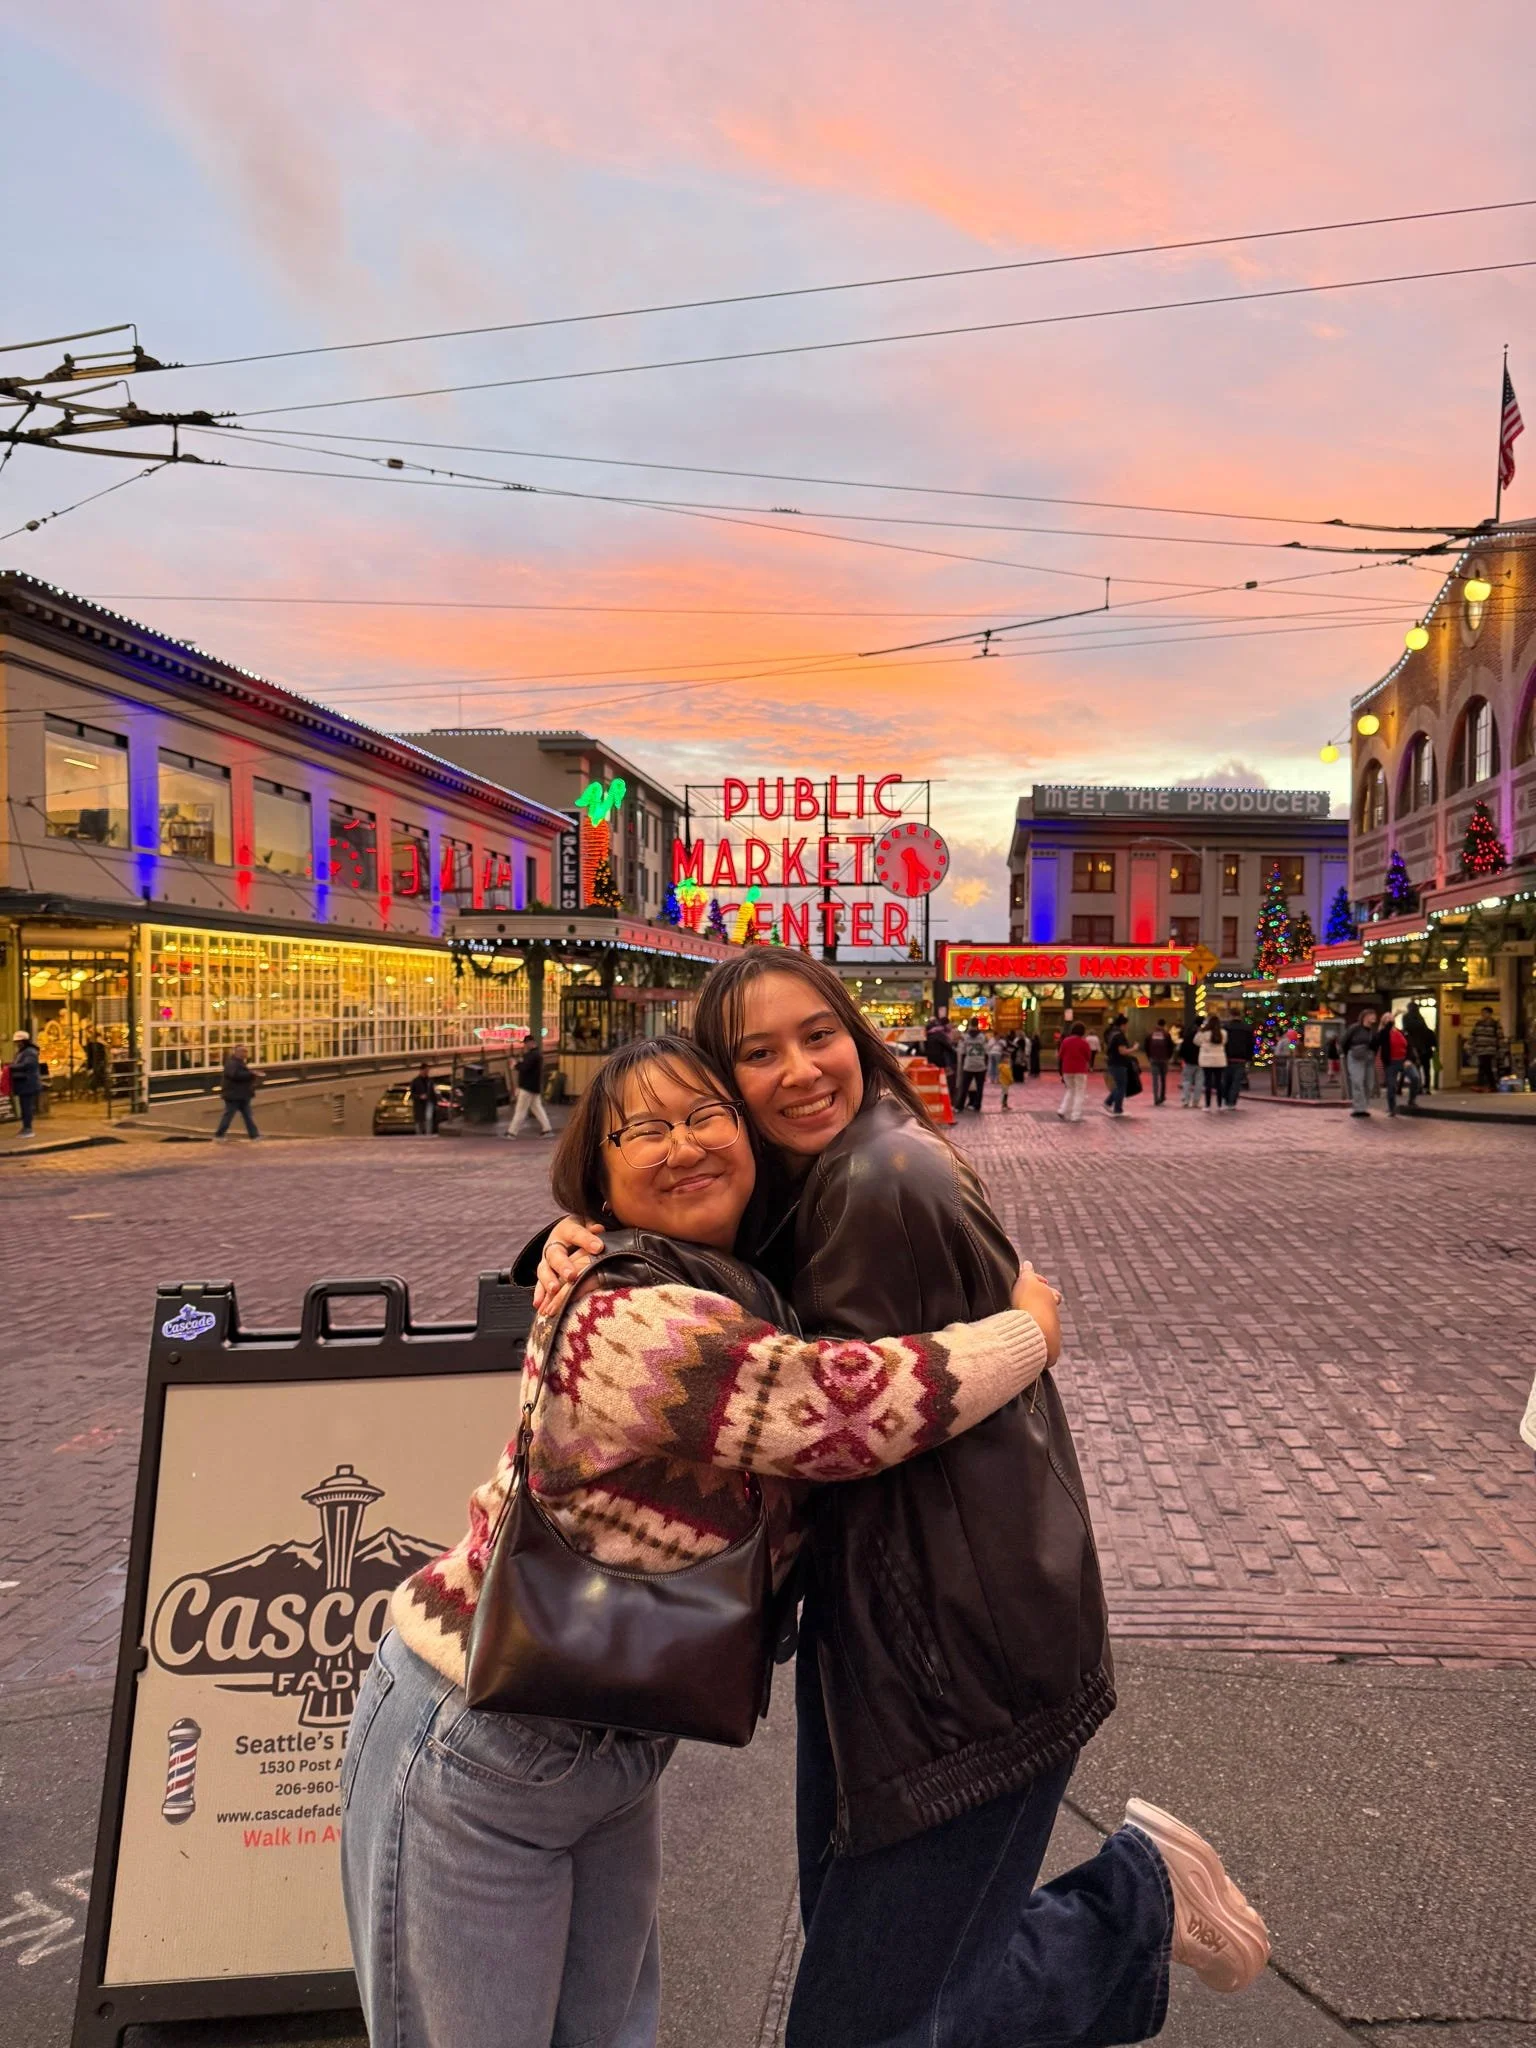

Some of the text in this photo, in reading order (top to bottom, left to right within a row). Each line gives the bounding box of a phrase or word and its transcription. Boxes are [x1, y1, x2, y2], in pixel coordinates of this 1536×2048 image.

[724, 774, 902, 821] PUBLIC
[1044, 789, 1322, 813] MEET THE PRODUCER
[672, 836, 874, 887] MARKET
[562, 889, 577, 909] HO
[719, 902, 909, 947] ENTER
[955, 953, 1183, 978] FARMERS MARKET
[165, 1316, 214, 1334] Cascade
[156, 1578, 394, 1665] Casca
[259, 1760, 295, 1774] 1530
[299, 1759, 331, 1773] Post
[275, 1781, 339, 1796] 206-960-
[217, 1804, 342, 1823] www.cascadefade
[243, 1827, 290, 1848] Walk
[298, 1827, 316, 1845] In
